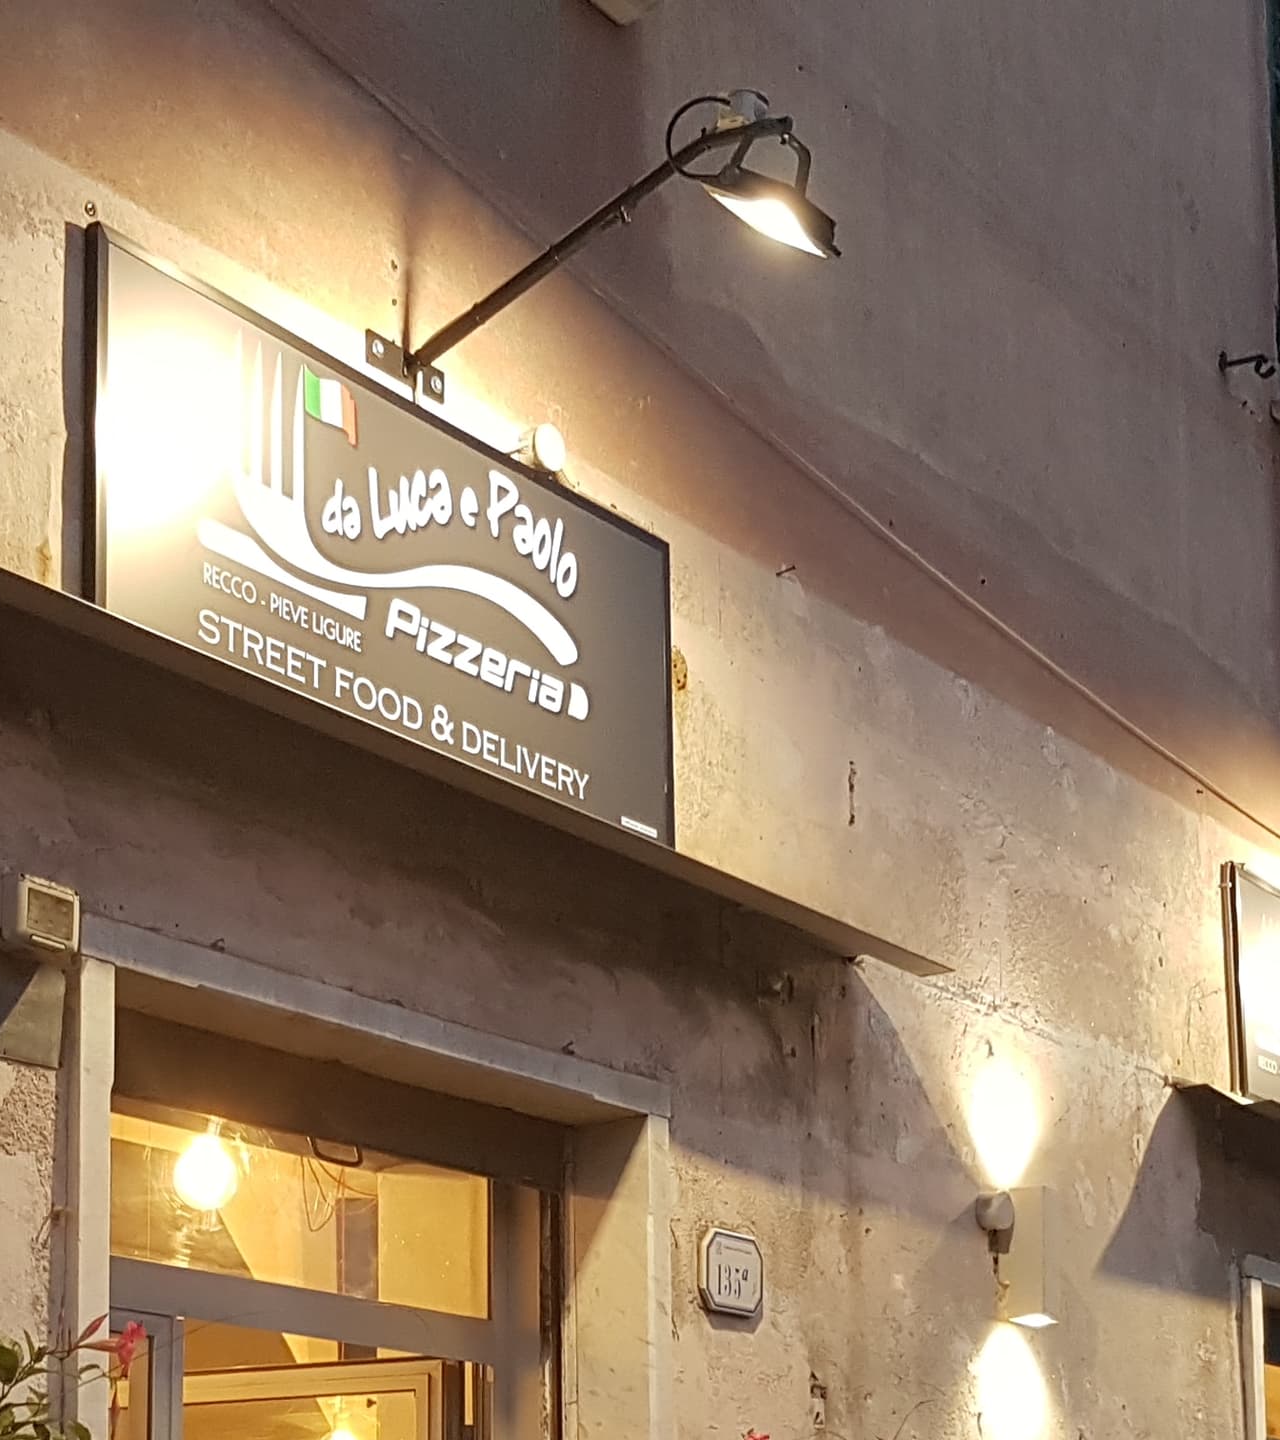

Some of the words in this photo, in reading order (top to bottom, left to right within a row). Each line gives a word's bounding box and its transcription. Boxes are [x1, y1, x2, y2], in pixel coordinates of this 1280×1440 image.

[322, 478, 361, 540] da
[368, 467, 453, 539] Luca
[460, 486, 479, 528] e
[487, 469, 577, 598] Paolo
[203, 562, 257, 604] RECCO
[270, 592, 309, 629] PIEVE
[312, 612, 362, 653] LIGURE
[385, 598, 565, 713] Pizzeria
[198, 609, 327, 689] STREET
[335, 666, 423, 730] FOOD
[431, 704, 454, 744] &
[462, 721, 590, 800] DELIVERY
